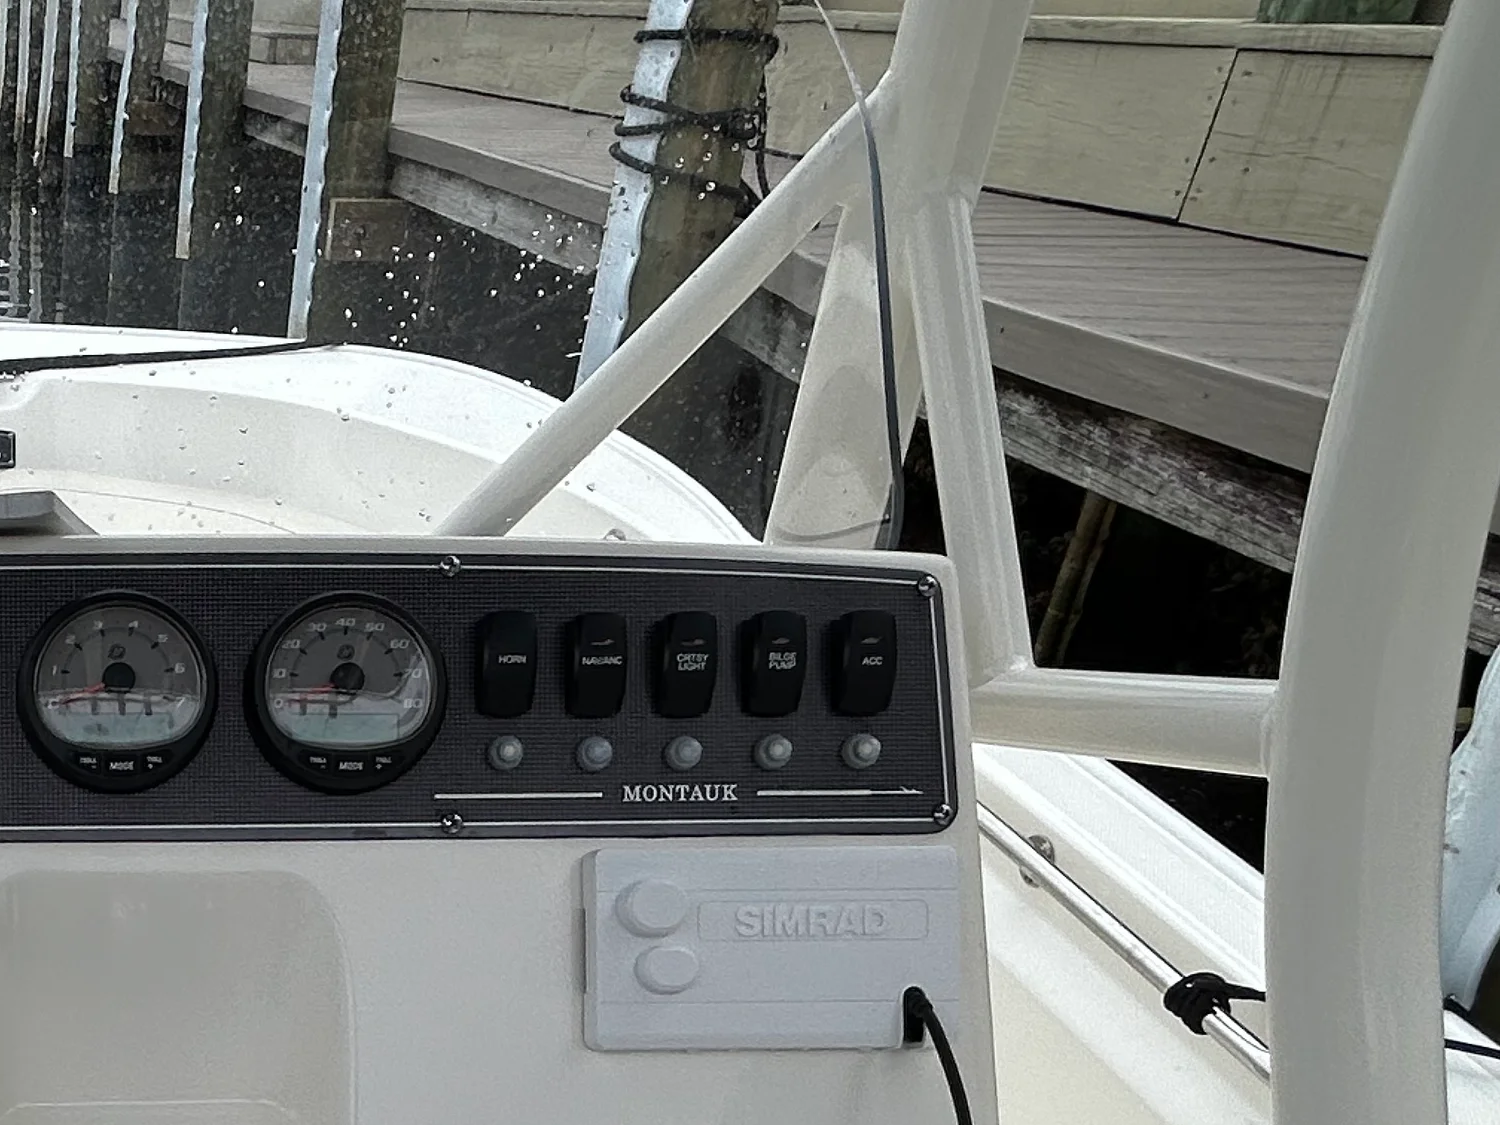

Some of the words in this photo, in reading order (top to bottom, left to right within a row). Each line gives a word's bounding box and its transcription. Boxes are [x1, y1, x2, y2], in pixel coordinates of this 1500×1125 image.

[308, 622, 327, 632] 30
[335, 617, 356, 627] 40
[282, 639, 300, 649] 20
[390, 639, 410, 649] 60
[498, 655, 527, 664] HORN
[676, 653, 709, 663] CRTSY
[769, 652, 797, 662] BILGE
[862, 656, 884, 666] ACC
[677, 662, 706, 671] LIGHT
[769, 661, 797, 670] PUMP
[272, 668, 287, 679] 10
[622, 783, 739, 802] MONTAUK
[734, 904, 889, 938] SIMRAD
